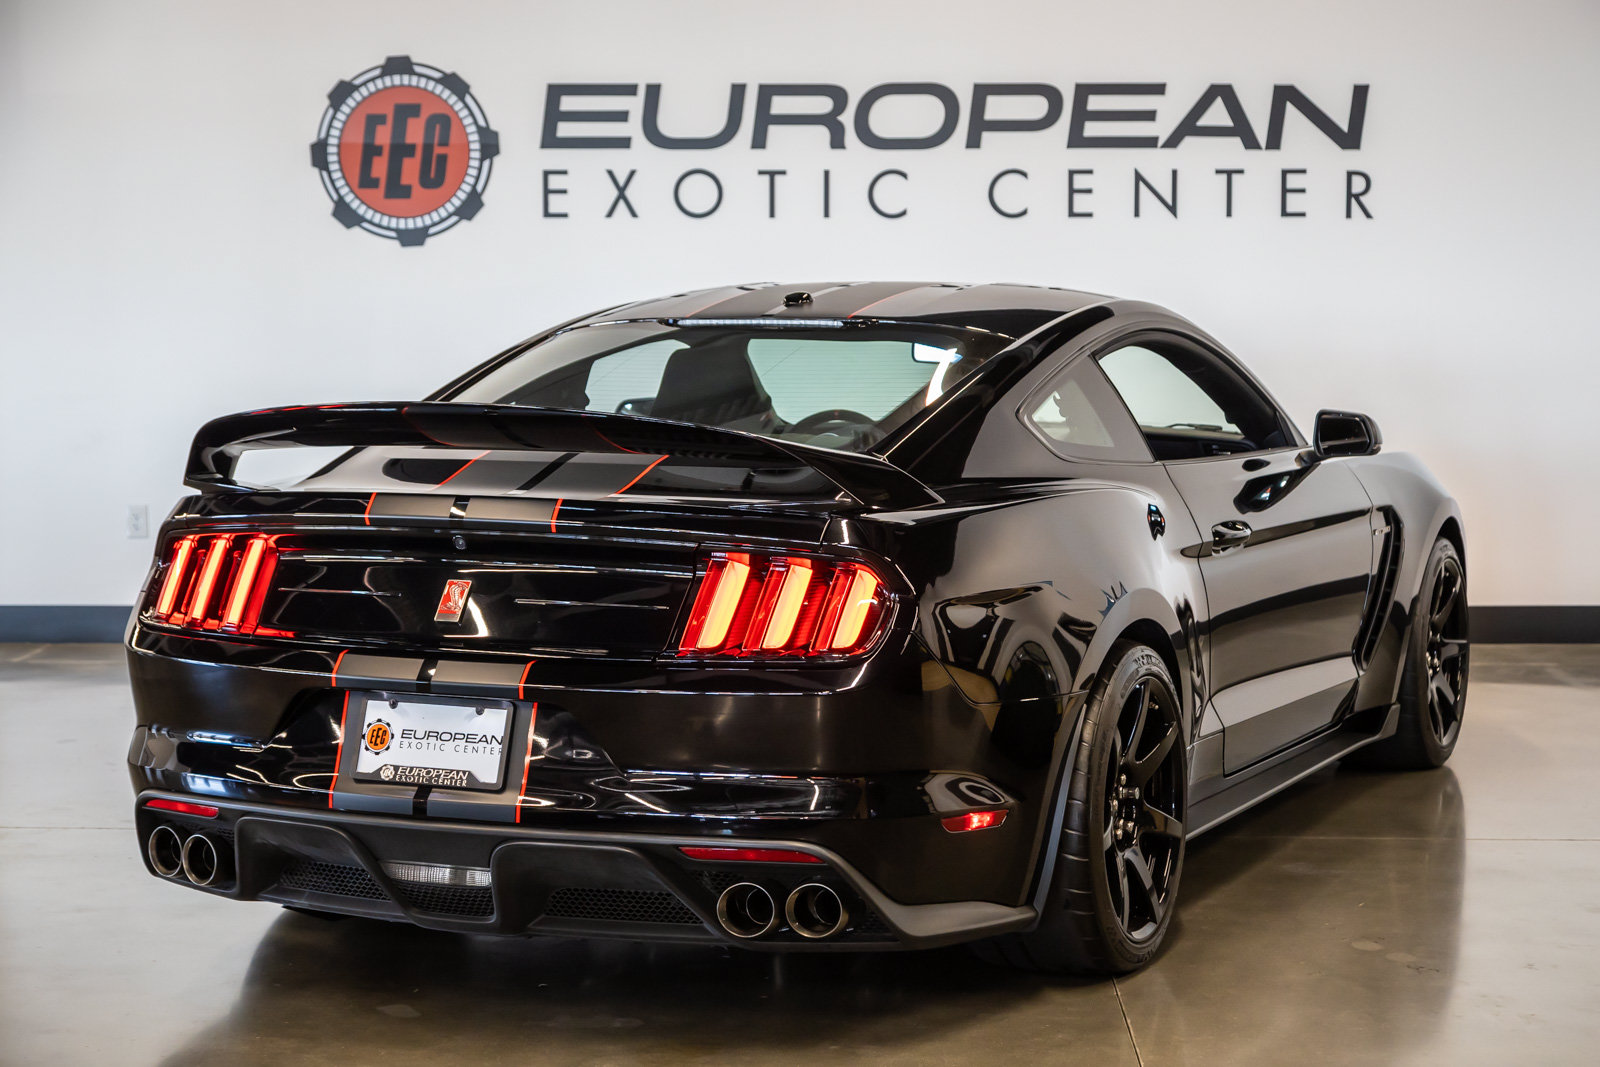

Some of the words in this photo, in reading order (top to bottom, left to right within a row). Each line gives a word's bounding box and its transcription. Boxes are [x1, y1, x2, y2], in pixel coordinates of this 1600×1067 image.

[540, 82, 1370, 150] EUROPEAN
[358, 103, 452, 199] EEC
[543, 168, 908, 219] EXOTIC
[987, 168, 1374, 219] CENTER
[369, 727, 387, 747] EEC
[400, 728, 503, 745] EUROPEAN
[400, 740, 446, 752] EXOTIC
[395, 774, 429, 784] EXOTIC
[431, 777, 467, 787] CENTER
[397, 766, 469, 780] EUROPEAN
